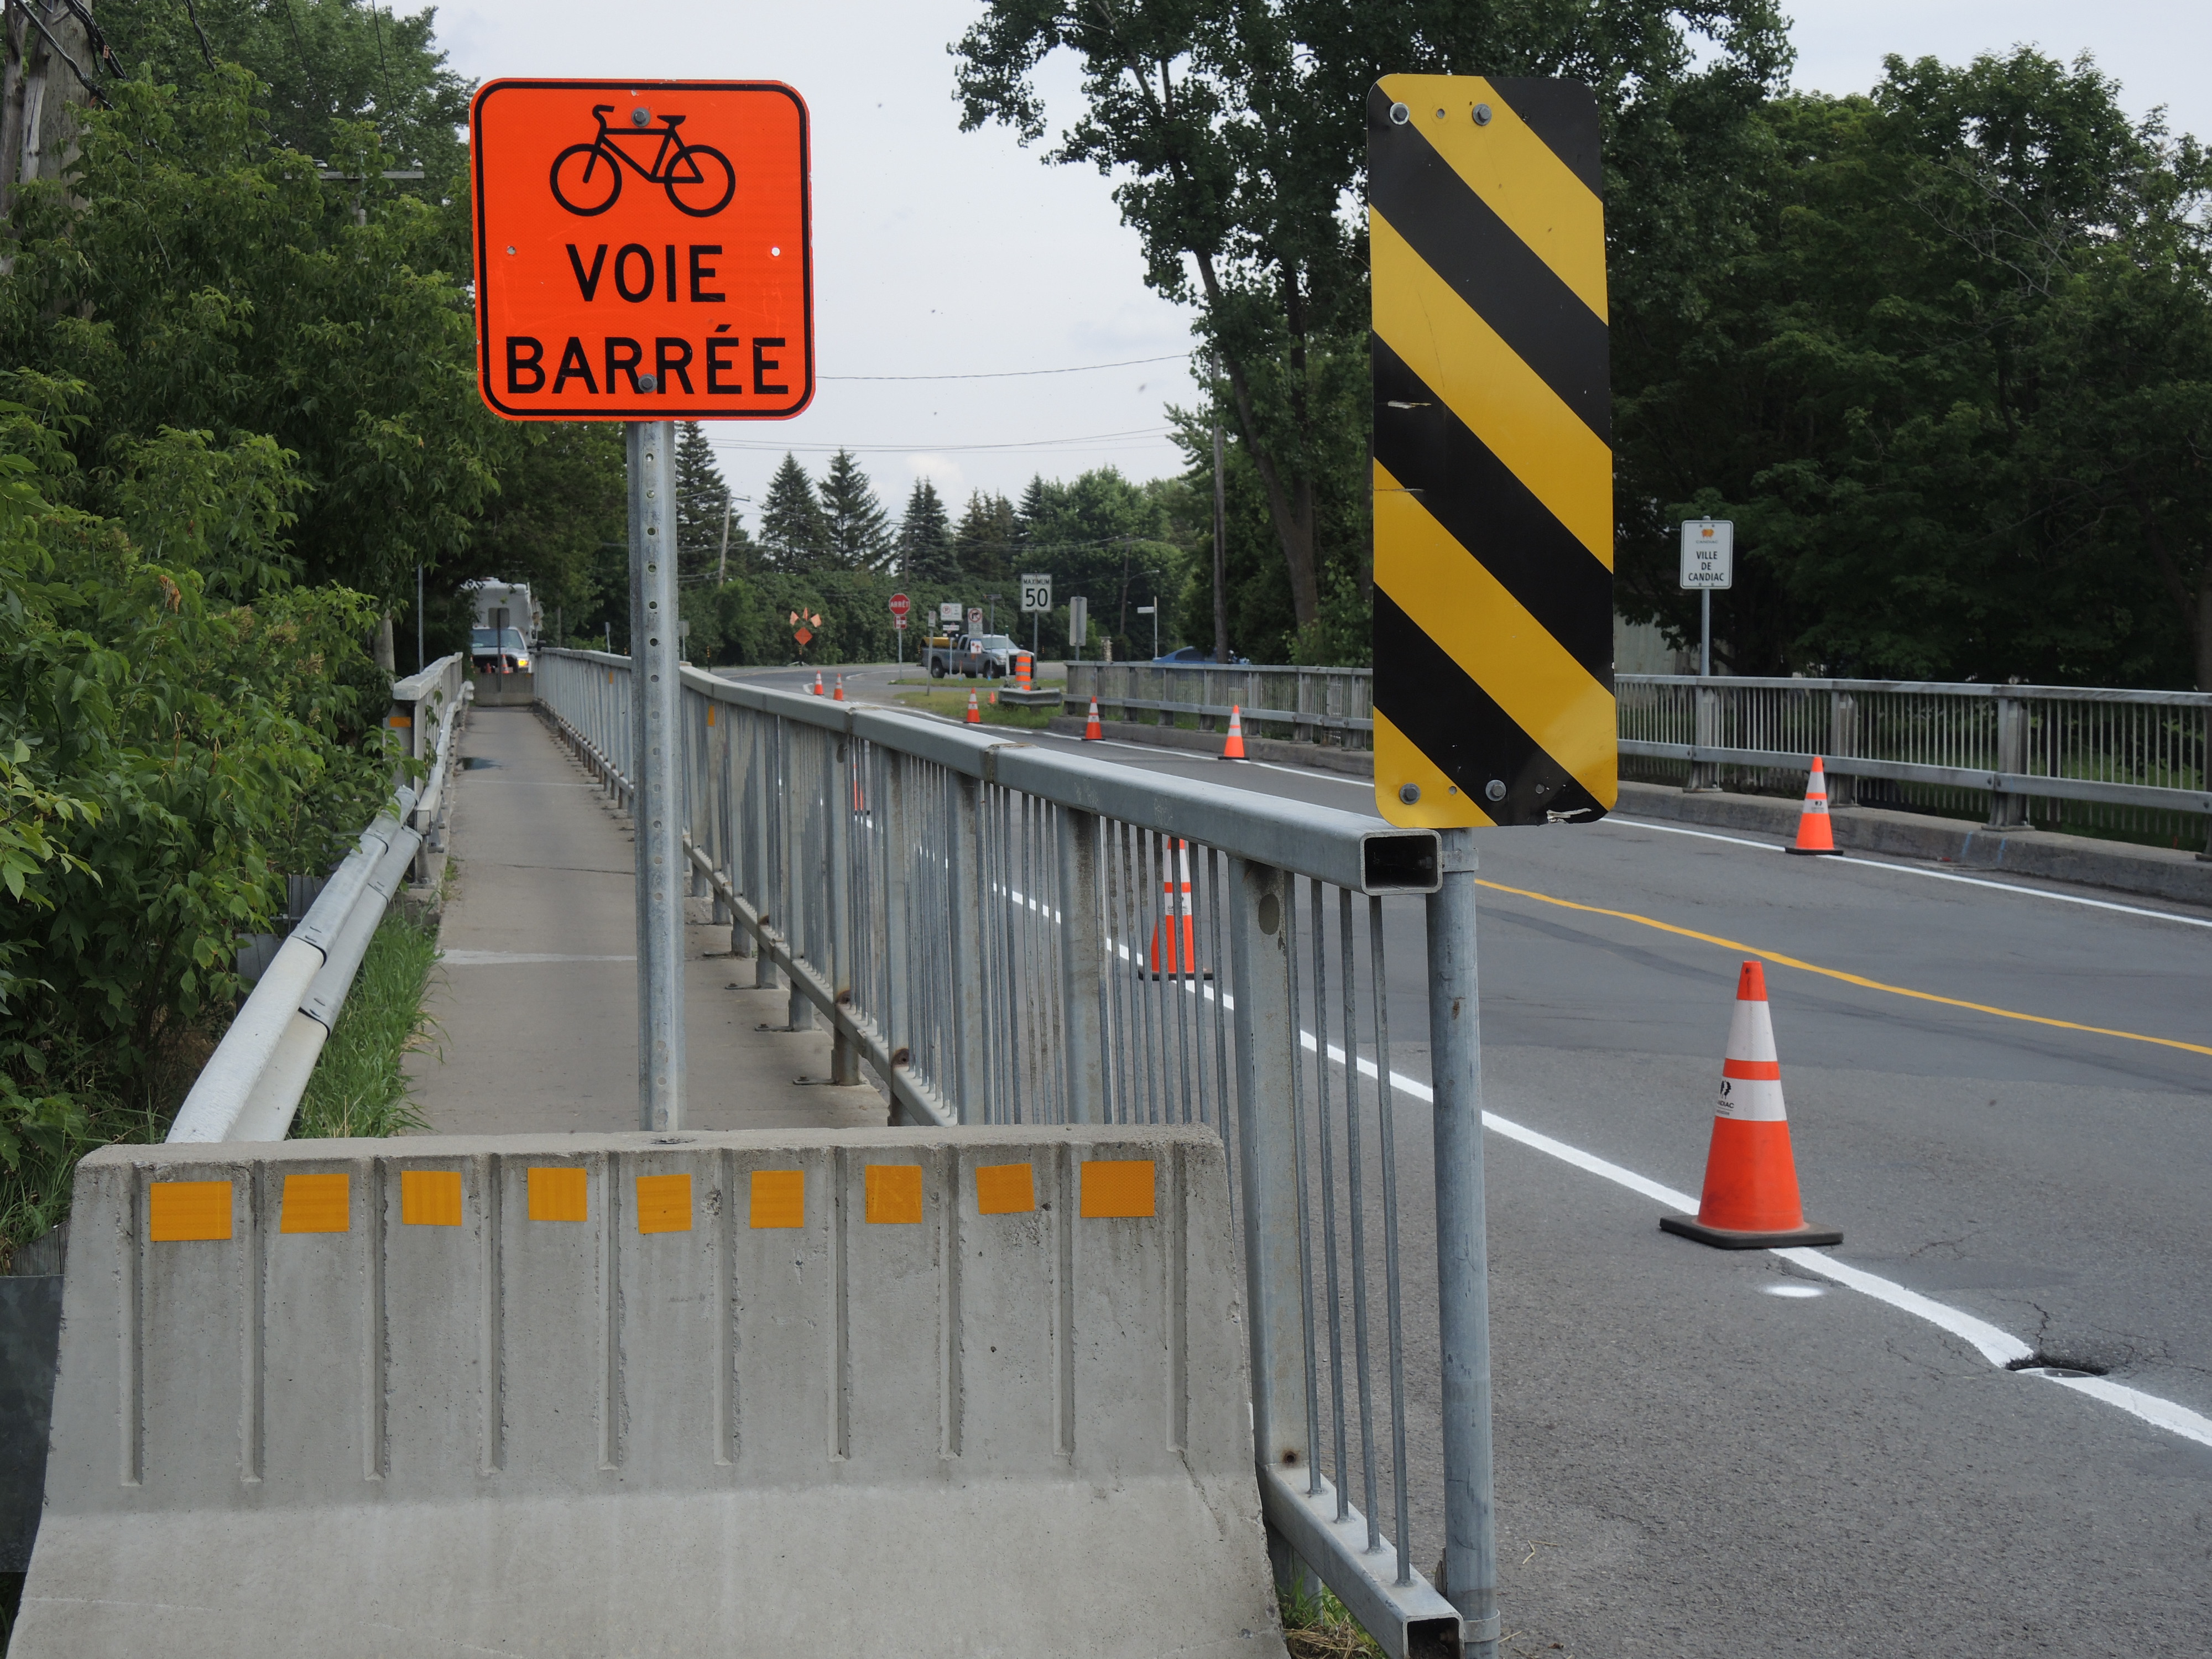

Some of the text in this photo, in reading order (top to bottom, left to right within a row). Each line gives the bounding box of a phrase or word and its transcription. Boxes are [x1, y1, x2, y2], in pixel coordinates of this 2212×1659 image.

[566, 243, 726, 303] VOIE
[506, 324, 789, 395] BARRÉE
[1696, 551, 1718, 560] VILLE
[1688, 573, 1724, 581] CANDIAC
[1026, 588, 1048, 607] 50
